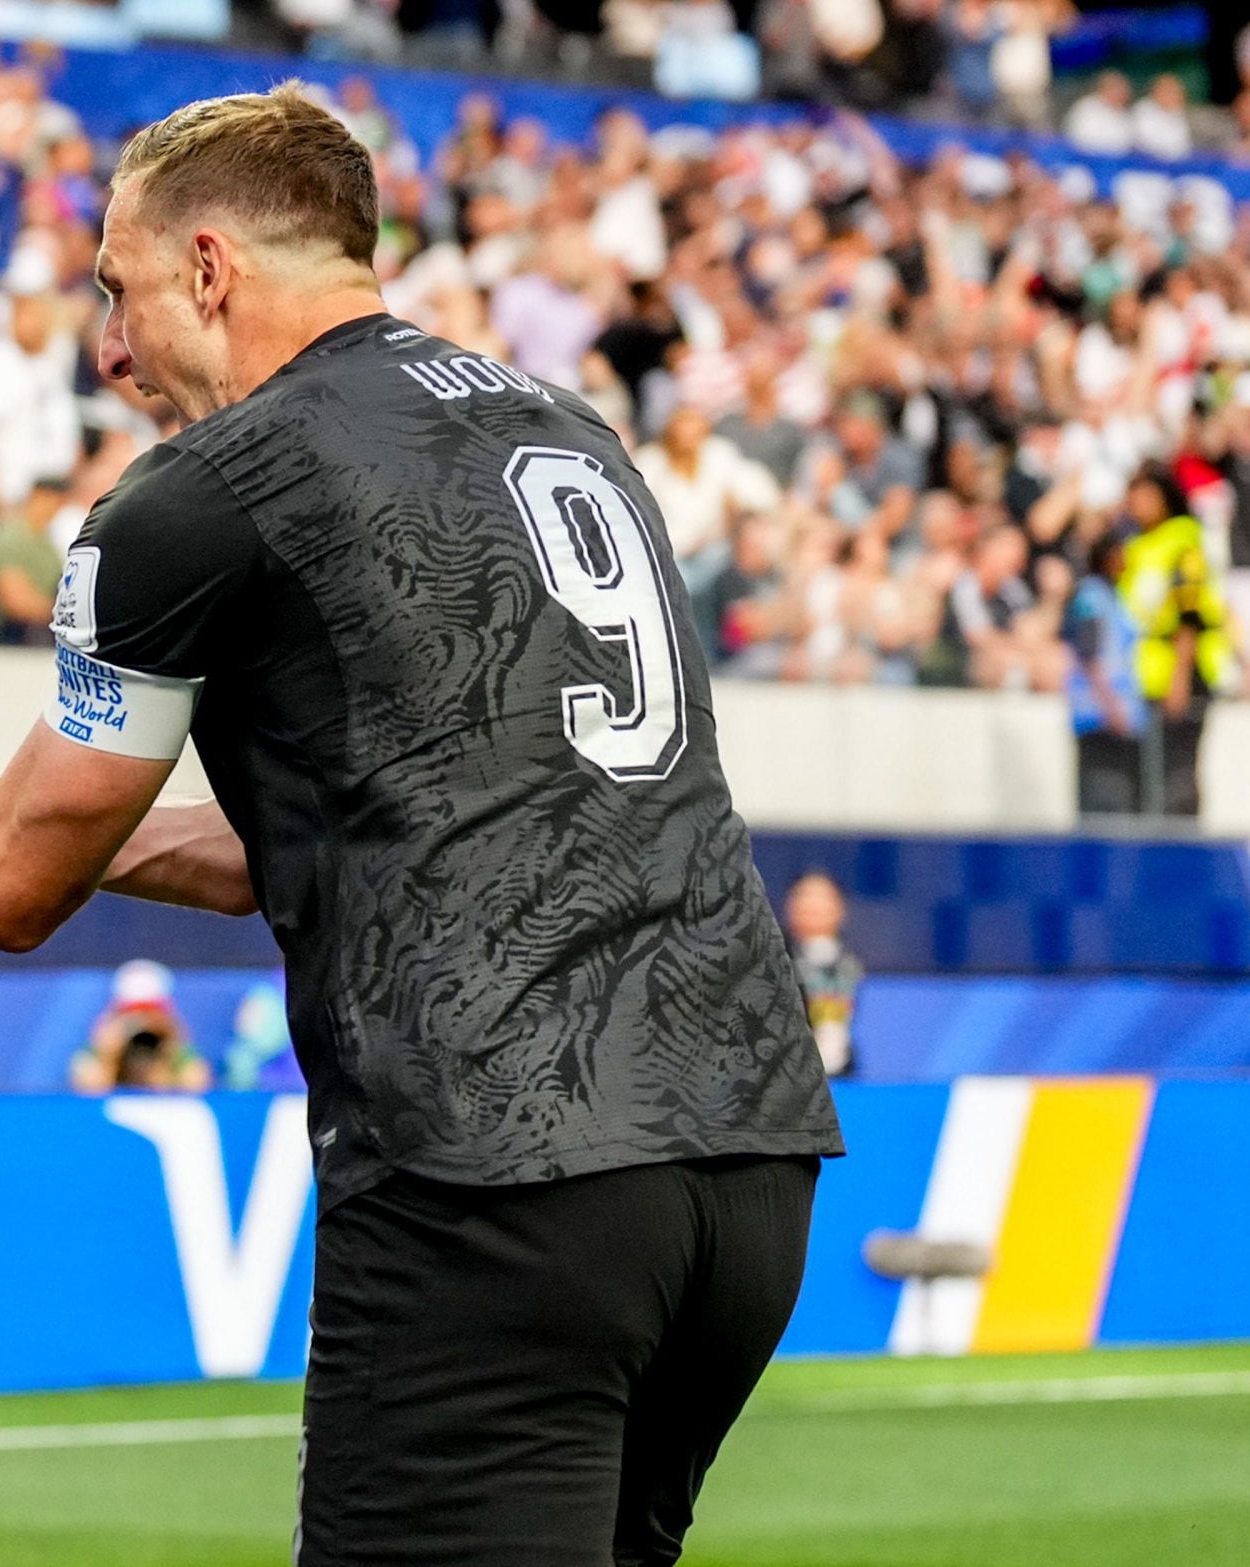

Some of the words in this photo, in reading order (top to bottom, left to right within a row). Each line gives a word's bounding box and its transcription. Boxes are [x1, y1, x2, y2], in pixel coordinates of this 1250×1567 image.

[502, 446, 688, 783] 9
[58, 645, 120, 681] OOTBALL
[61, 718, 91, 741] FIFA
[73, 694, 128, 732] World
